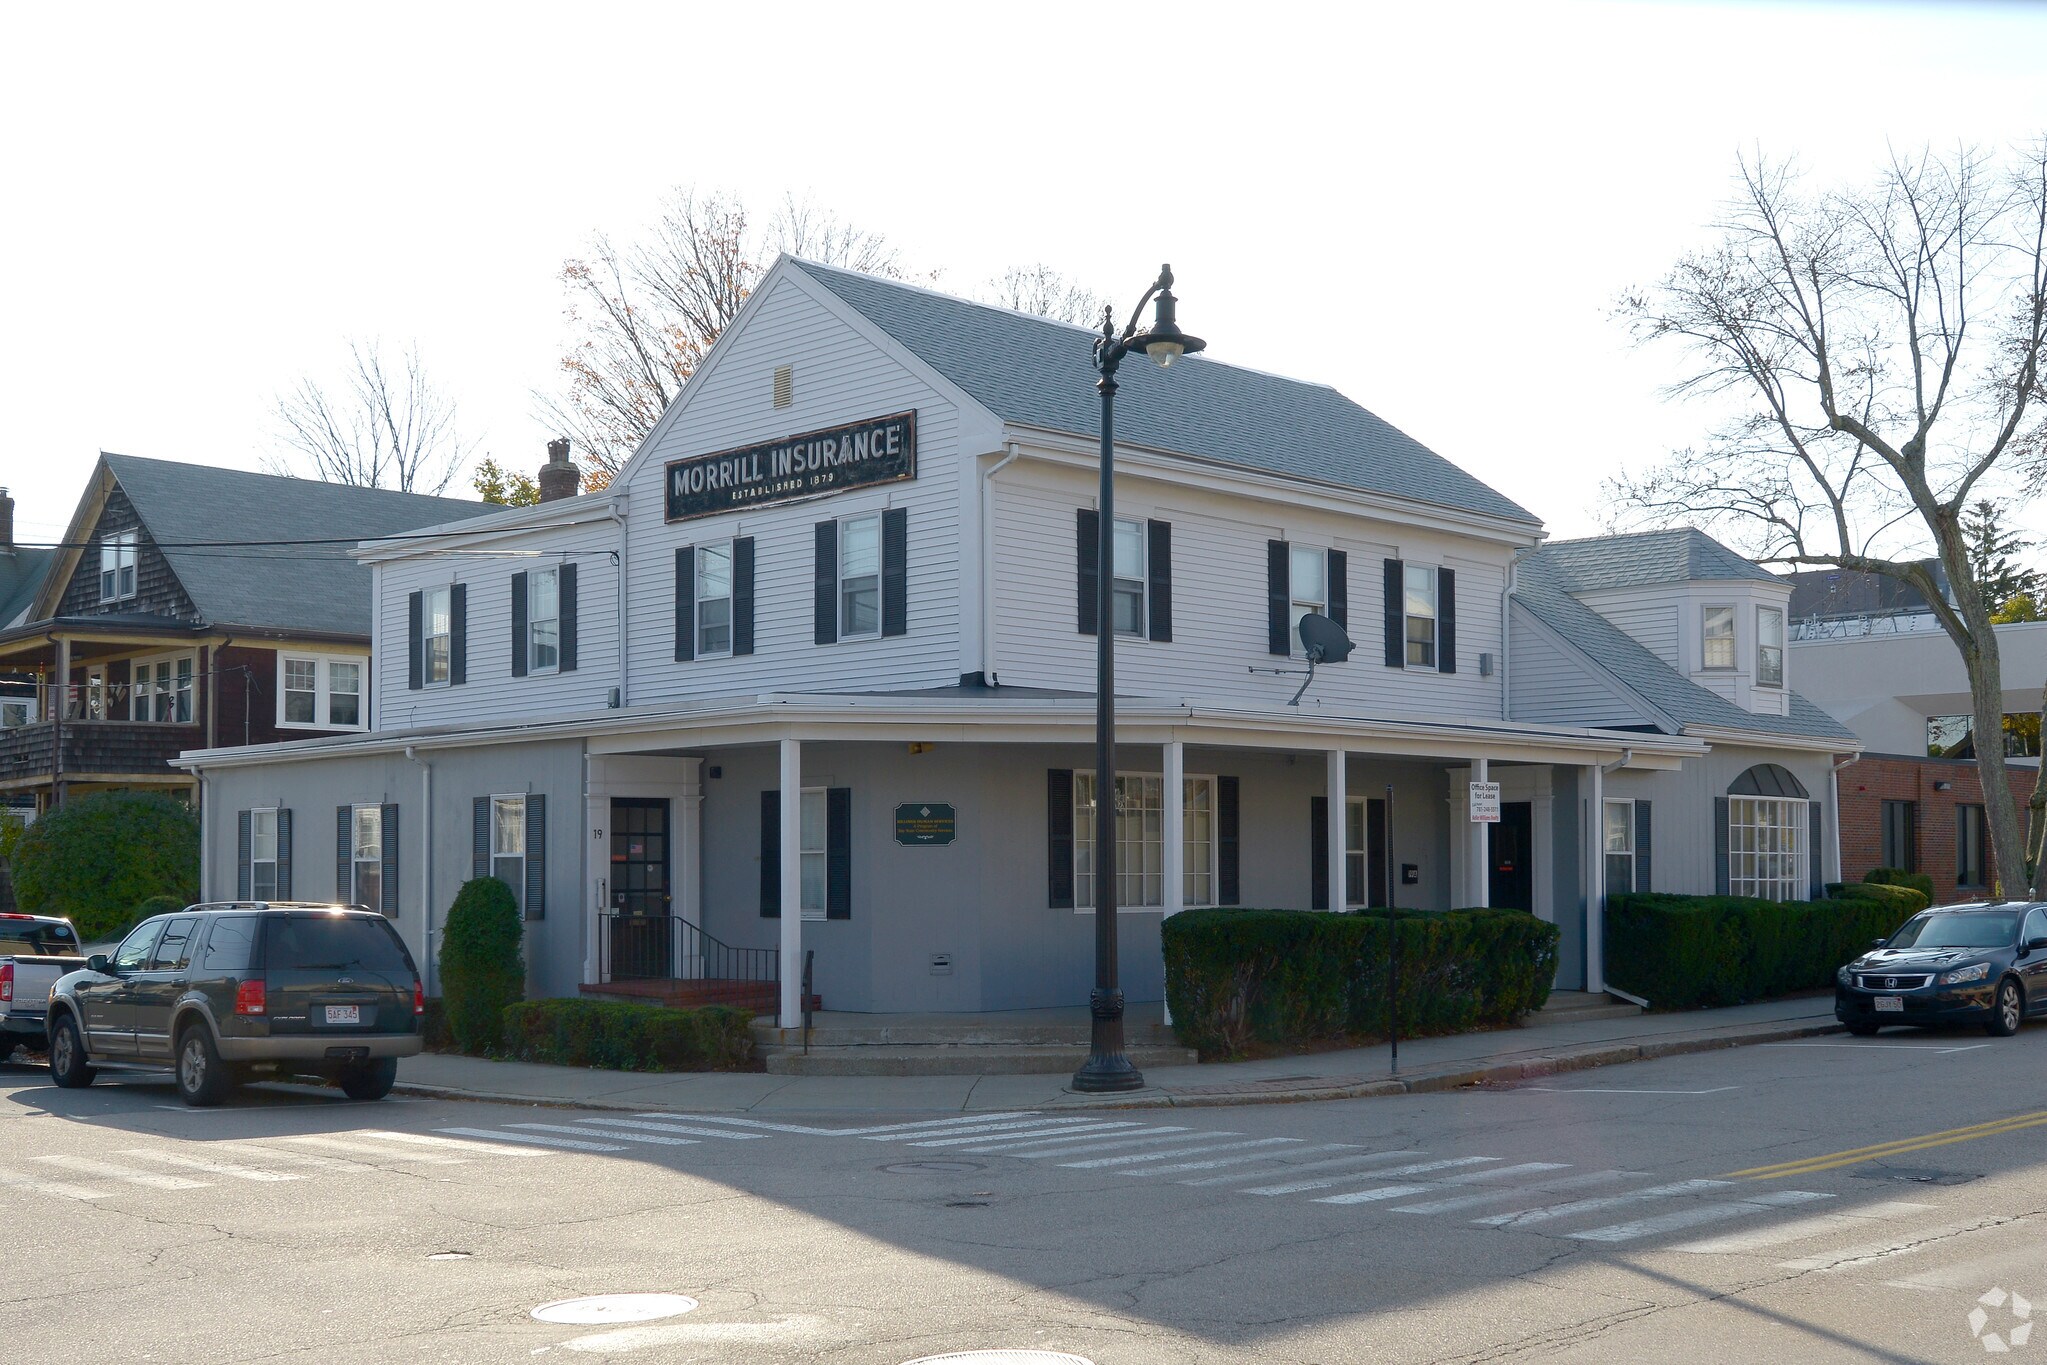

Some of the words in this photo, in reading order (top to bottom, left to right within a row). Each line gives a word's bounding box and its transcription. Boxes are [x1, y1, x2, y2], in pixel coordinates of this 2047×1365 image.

[674, 454, 763, 496] MORRILL
[771, 426, 900, 477] INSURANCE
[732, 478, 802, 500] ESTABLISHED
[809, 472, 834, 486] 1879
[1485, 784, 1498, 792] Space
[1482, 792, 1496, 800] Lease
[593, 829, 603, 840] 19
[328, 1010, 341, 1019] 5AF
[343, 1010, 357, 1019] 345
